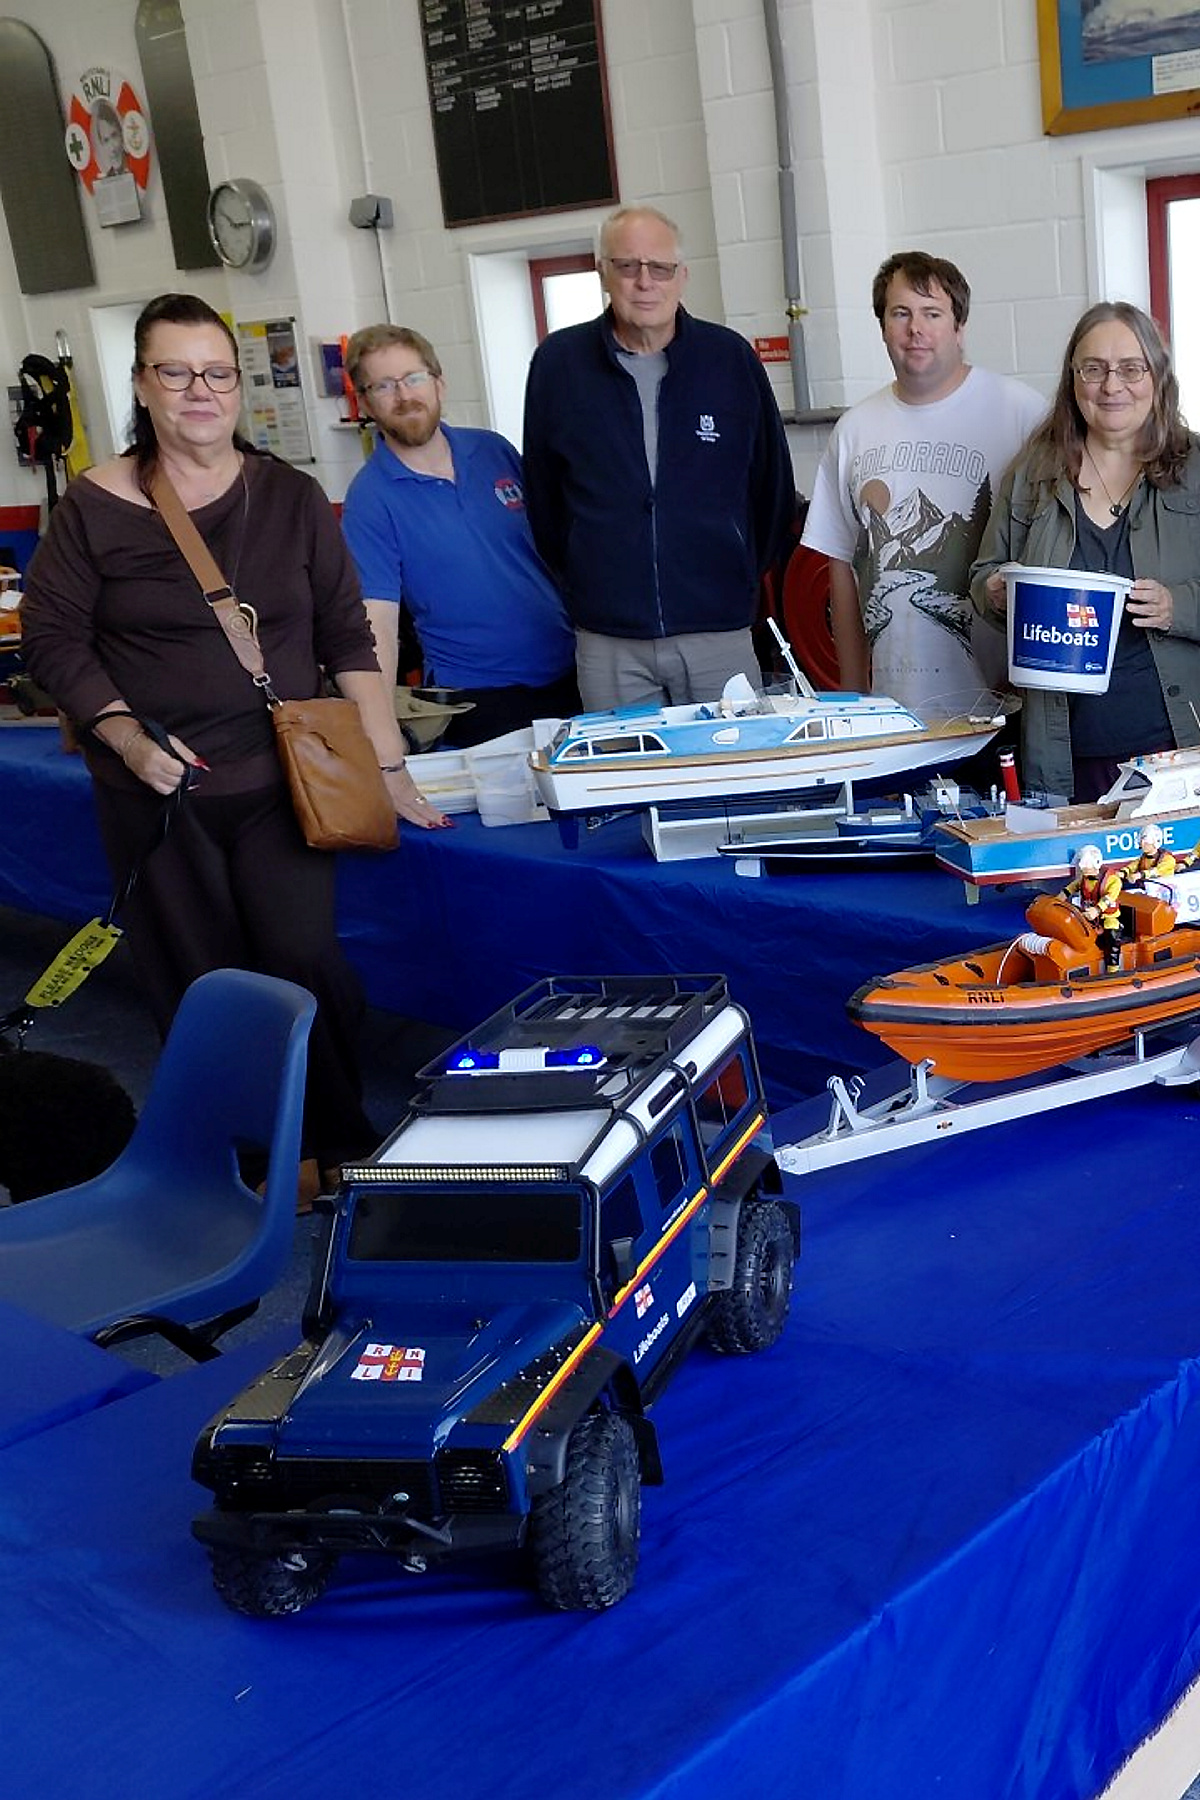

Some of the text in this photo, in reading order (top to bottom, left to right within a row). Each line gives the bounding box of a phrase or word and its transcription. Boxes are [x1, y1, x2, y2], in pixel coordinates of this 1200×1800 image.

[83, 76, 110, 103] RNLI
[850, 440, 985, 492] COLORADO
[1023, 623, 1099, 647] Lifeboats
[967, 991, 1005, 1003] RNLI
